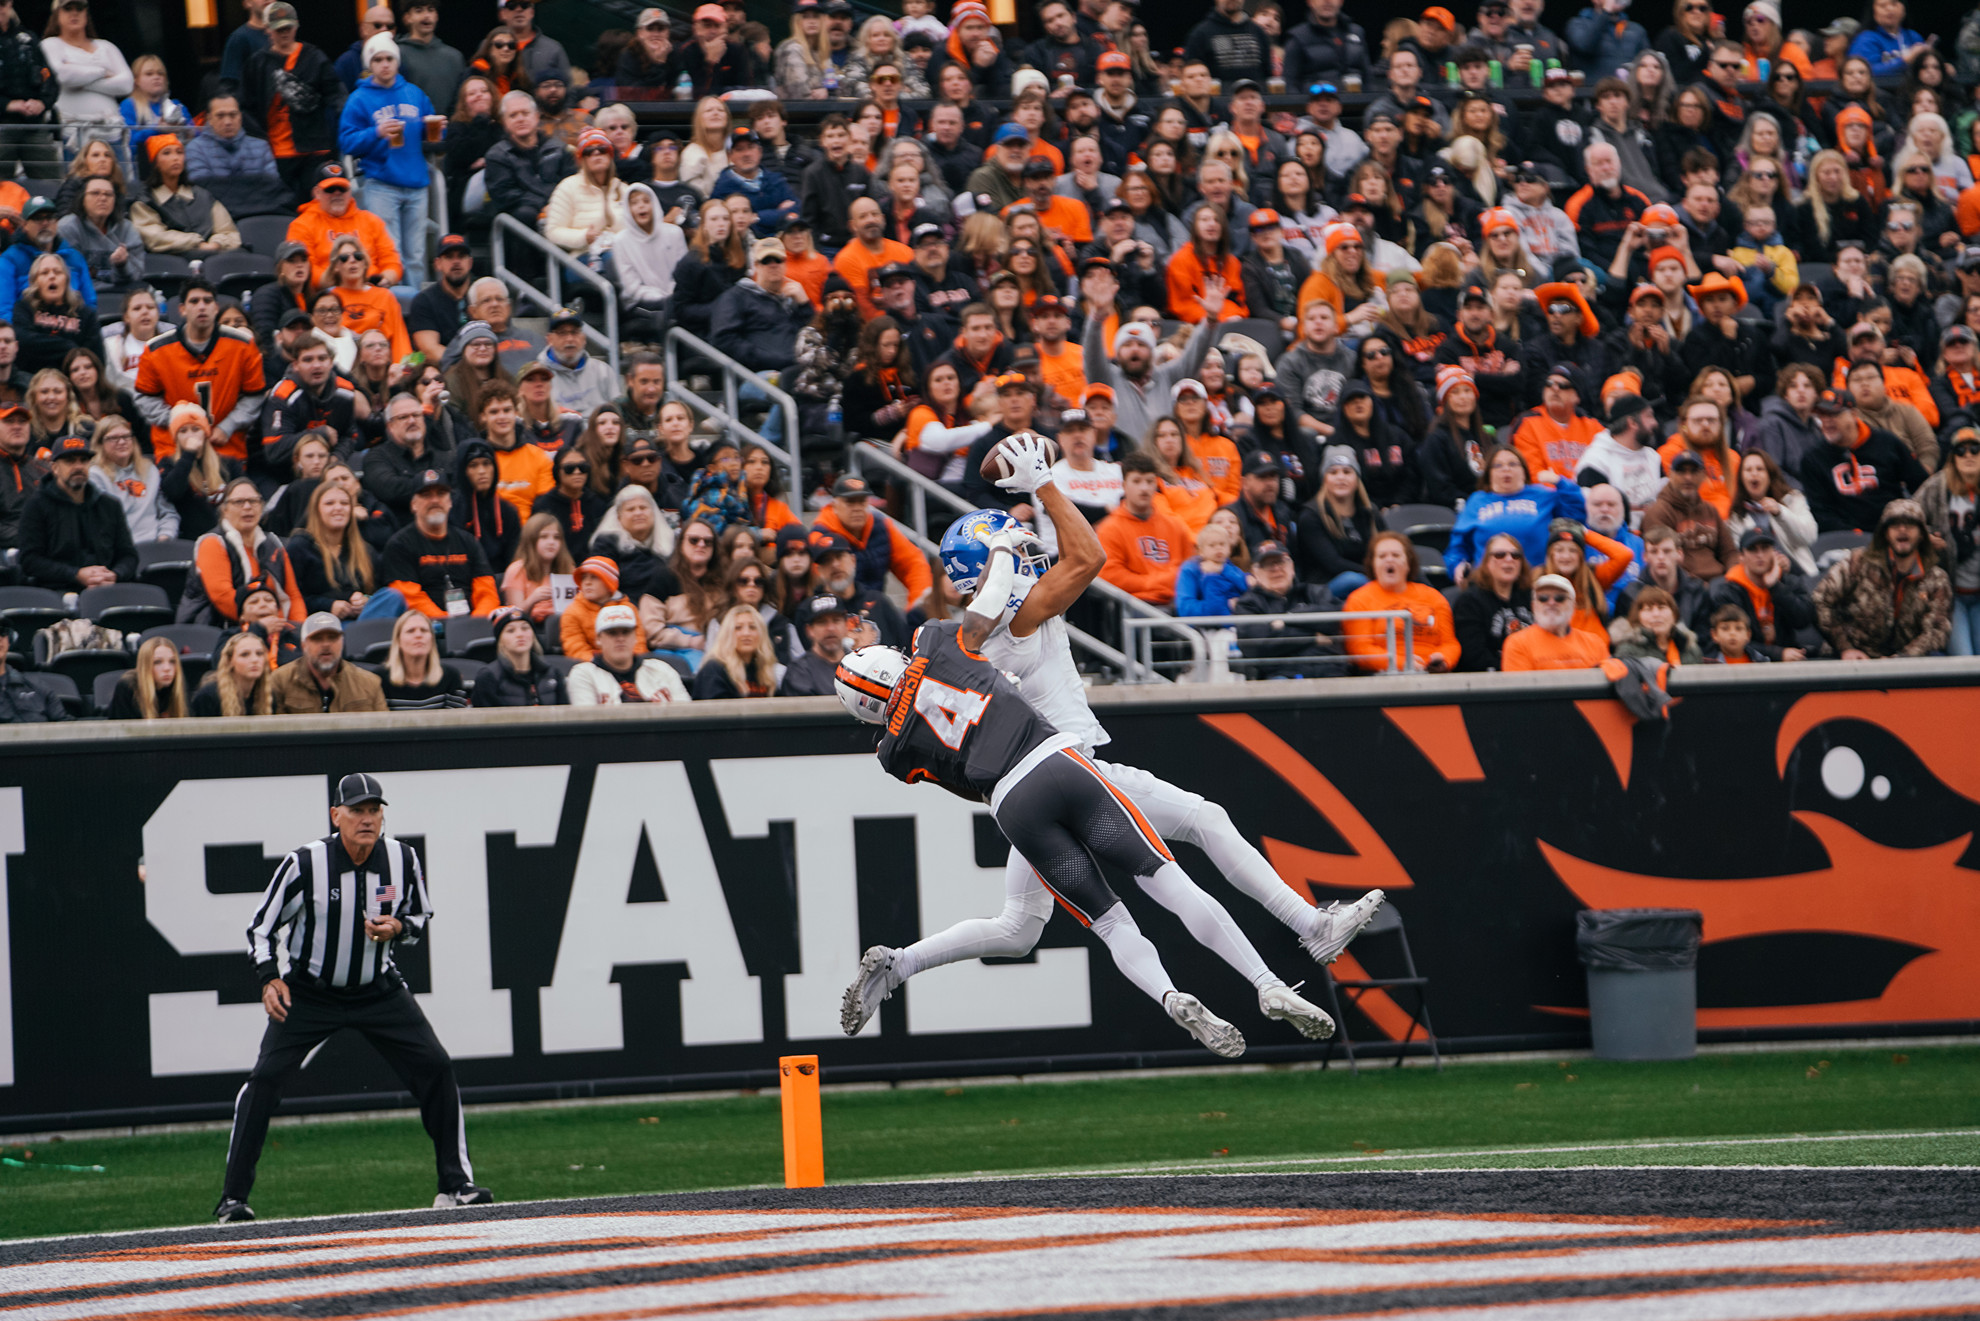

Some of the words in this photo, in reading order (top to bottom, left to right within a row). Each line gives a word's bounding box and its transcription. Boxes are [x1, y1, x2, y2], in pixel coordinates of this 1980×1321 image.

[1478, 502, 1503, 521] SAN
[888, 656, 930, 736] ROBINSON
[913, 675, 993, 751] 4
[143, 752, 1092, 1077] STATE
[329, 887, 339, 900] S
